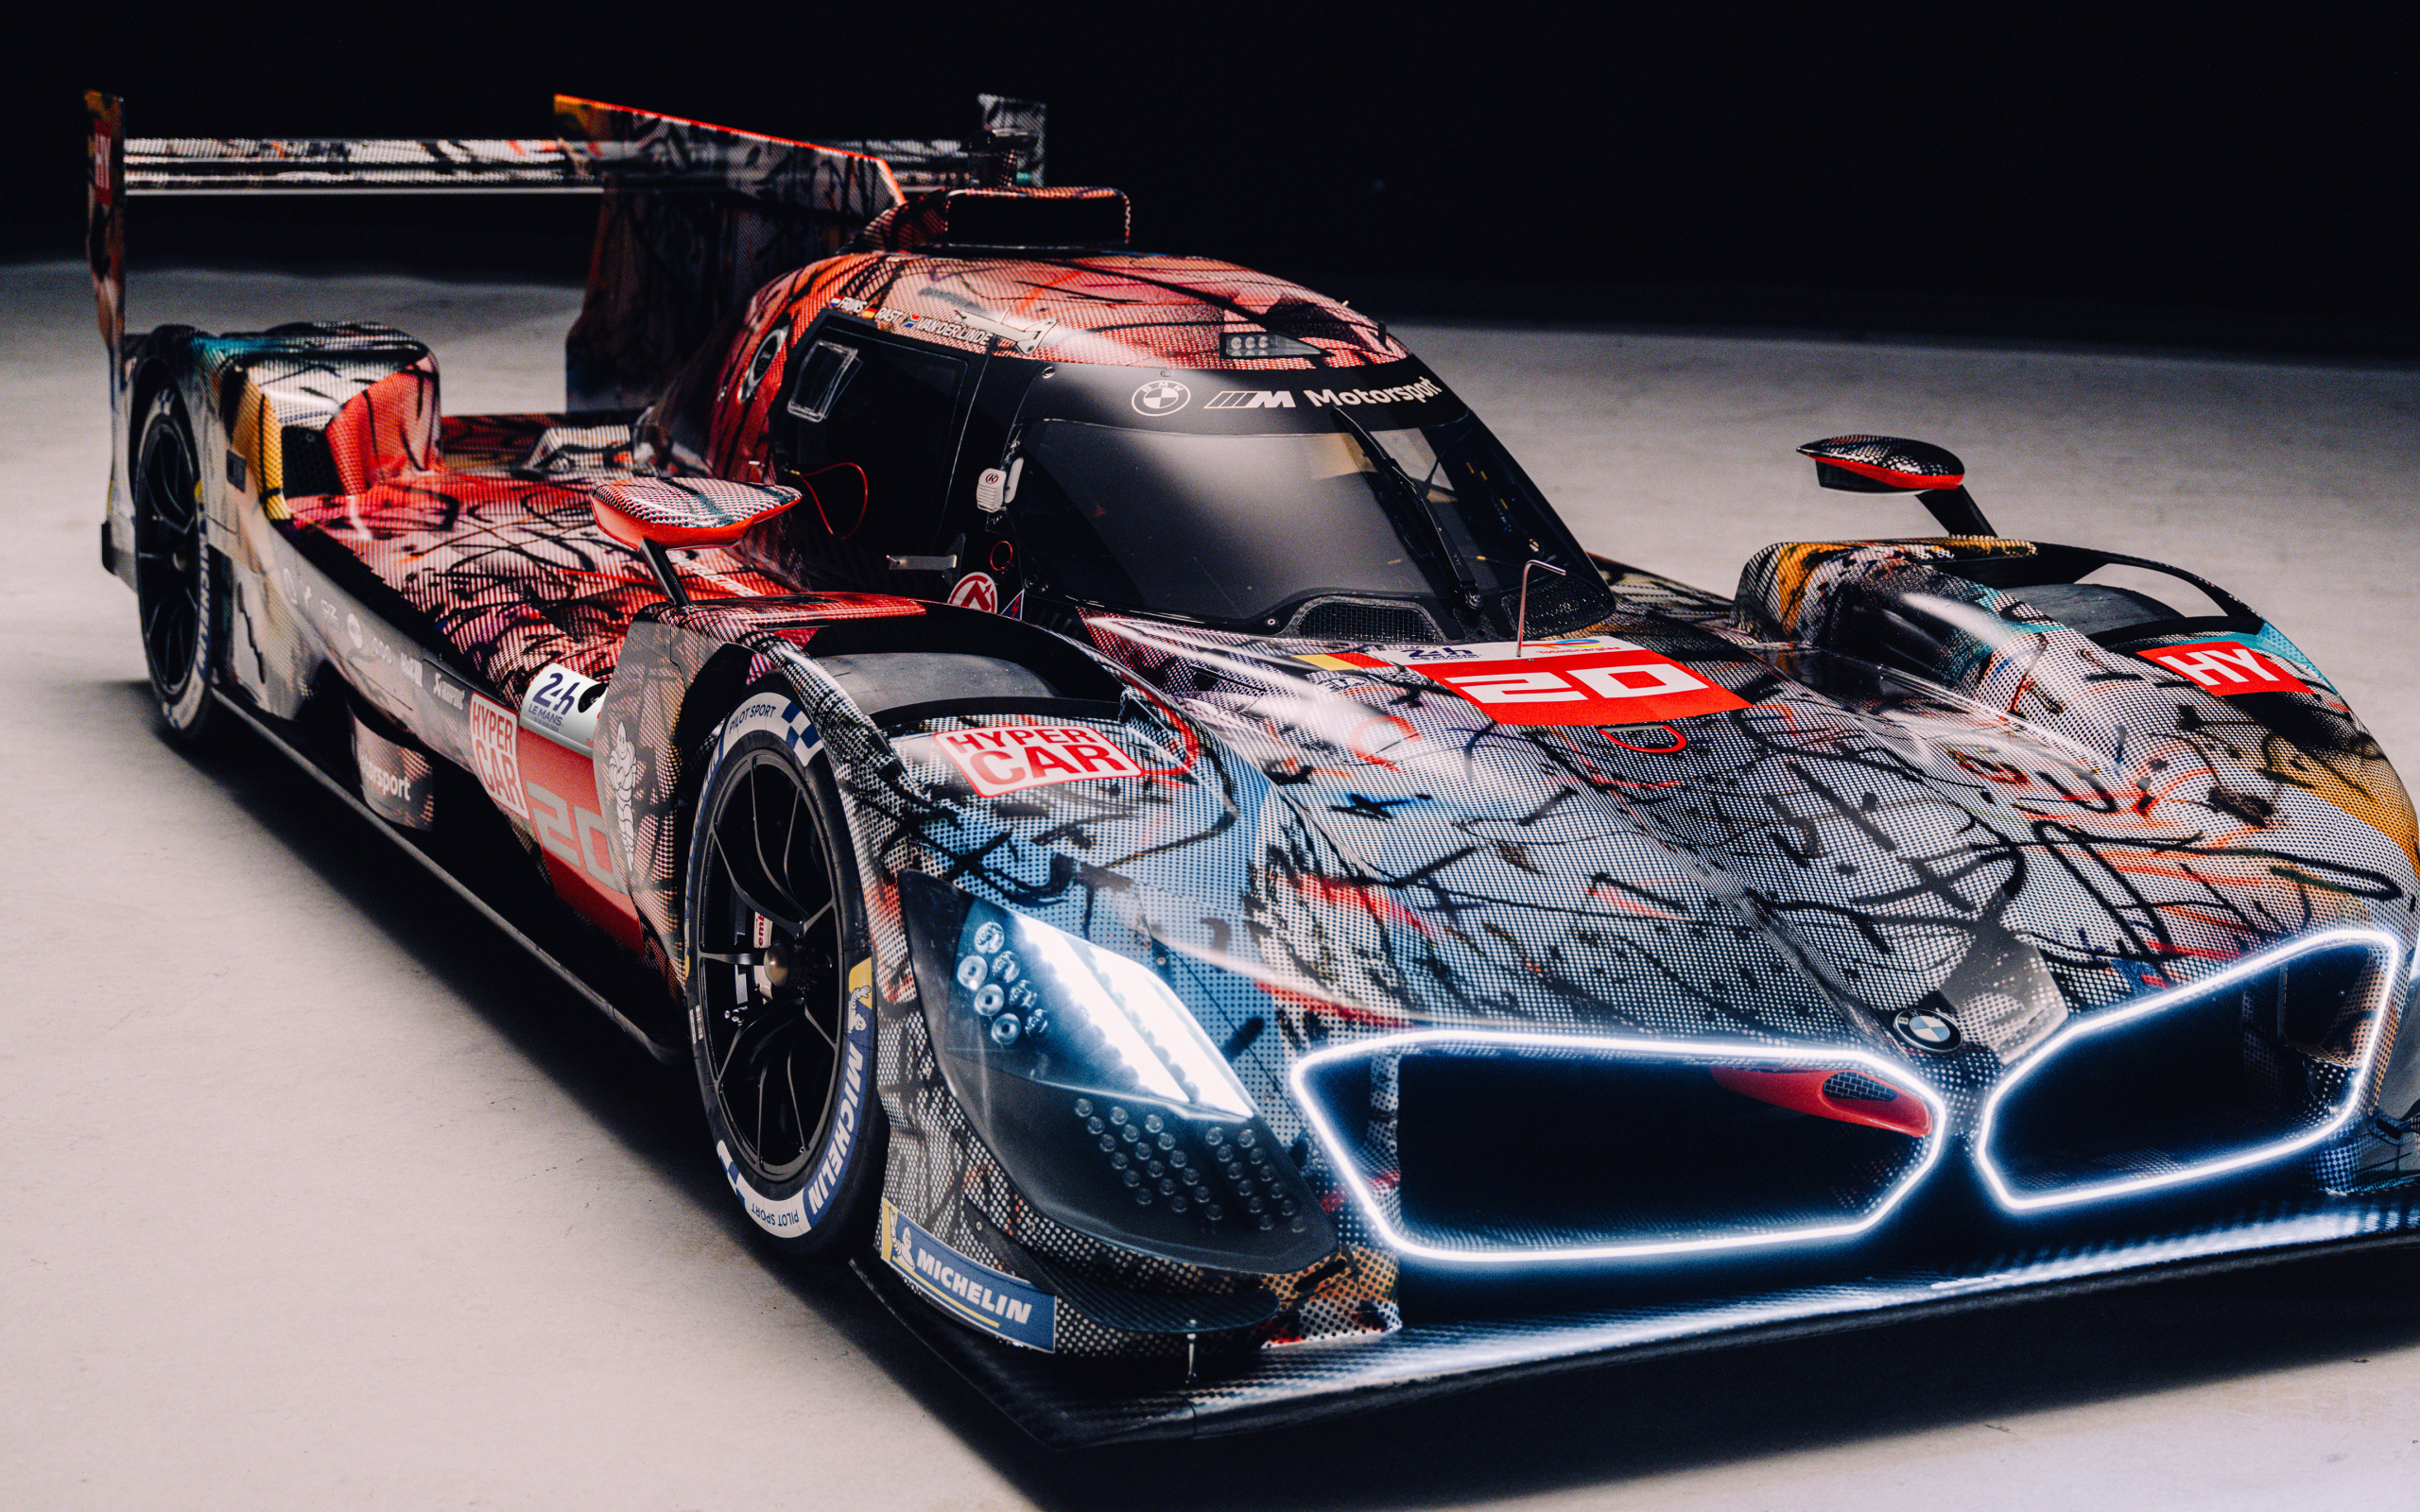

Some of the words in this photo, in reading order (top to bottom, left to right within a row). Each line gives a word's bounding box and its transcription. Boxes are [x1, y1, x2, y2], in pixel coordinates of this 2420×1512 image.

[874, 307, 905, 323] RAST
[916, 317, 940, 333] VAN
[936, 321, 961, 338] DER
[957, 325, 994, 345] LINDE
[1304, 375, 1443, 407] Motorsport
[1444, 663, 1709, 704] 20
[2156, 648, 2280, 686] HY
[532, 673, 580, 715] 24h
[473, 700, 513, 756] HYPER
[528, 703, 539, 715] LE
[538, 708, 563, 727] MANS
[729, 709, 751, 735] PILOT
[749, 704, 777, 719] SPORT
[946, 729, 1098, 754] HYPER
[475, 739, 527, 818] CAR
[970, 745, 1130, 785] CAR
[808, 1040, 864, 1215] MICHELIN
[752, 1204, 776, 1225] SPORT
[777, 1209, 800, 1227] PILOT
[917, 1247, 1032, 1324] MICHELIN
